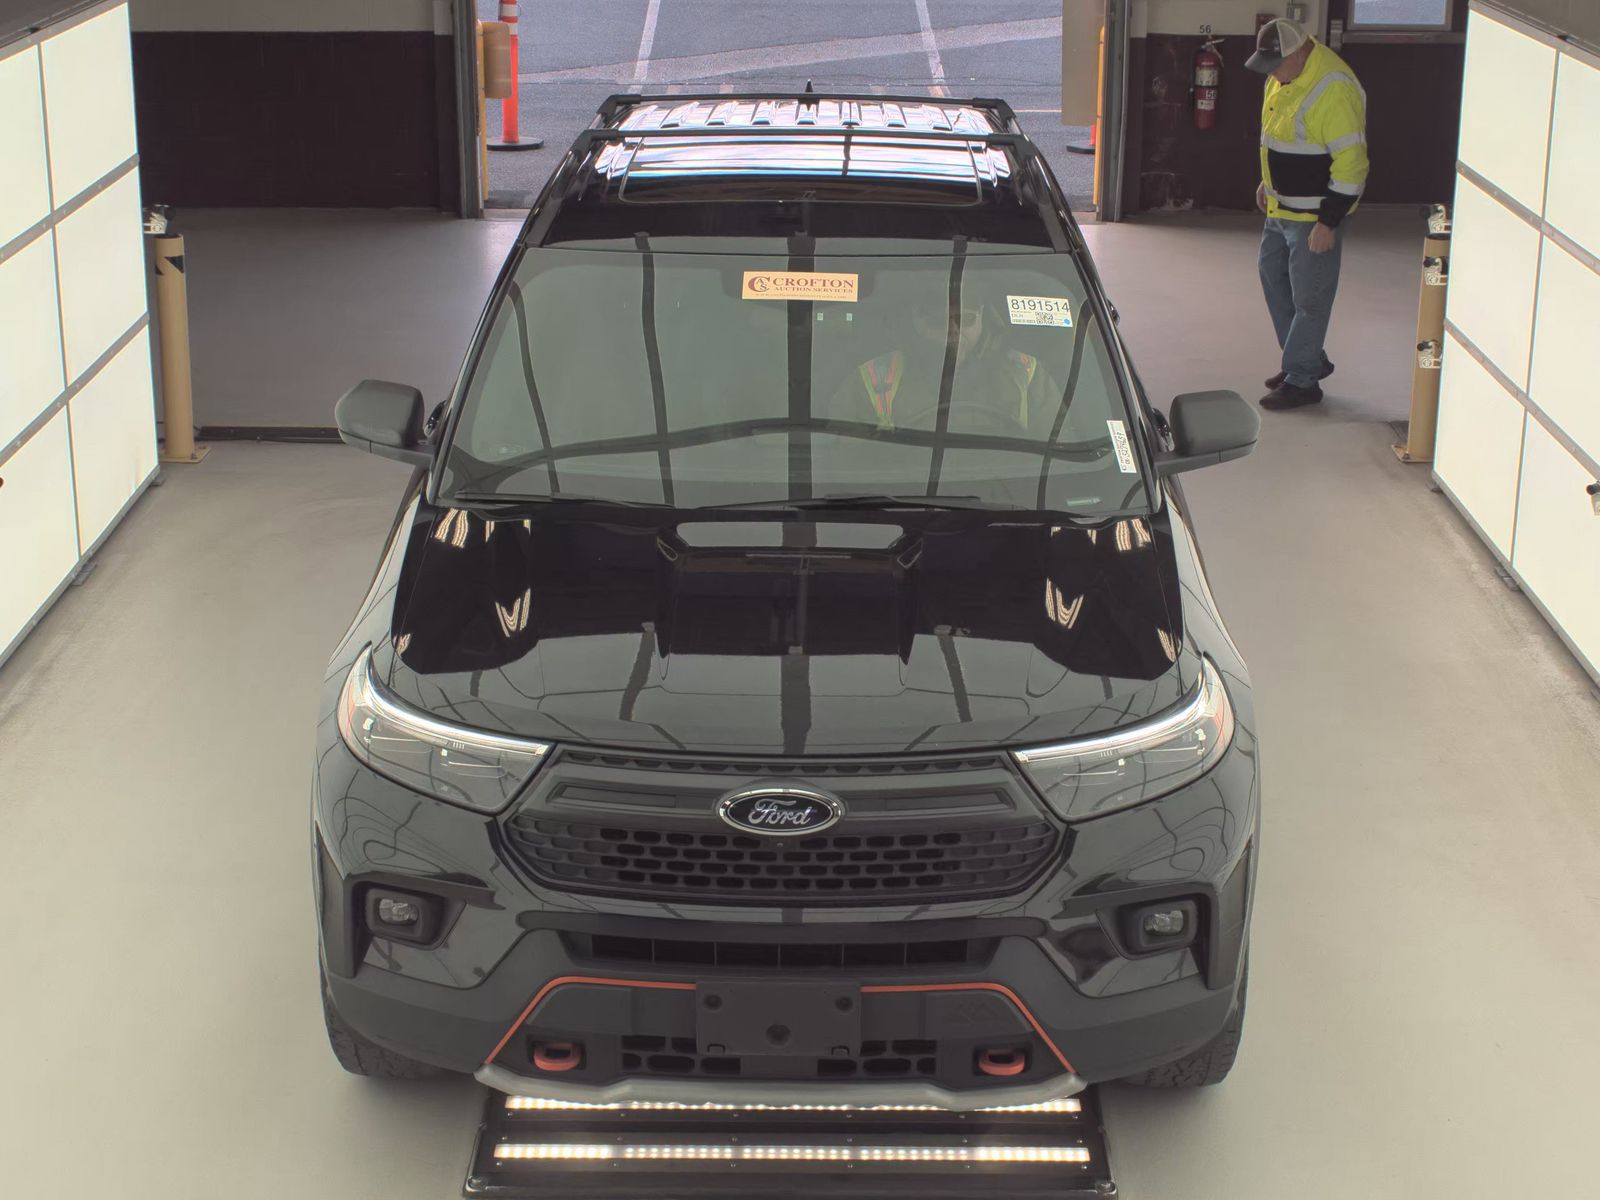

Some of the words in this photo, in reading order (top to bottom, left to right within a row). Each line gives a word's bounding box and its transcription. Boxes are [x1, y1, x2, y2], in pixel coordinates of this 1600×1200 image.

[1200, 25, 1211, 34] 56
[773, 278, 854, 288] CROFTON
[1011, 299, 1070, 312] 8191514
[748, 799, 813, 825] Ford
